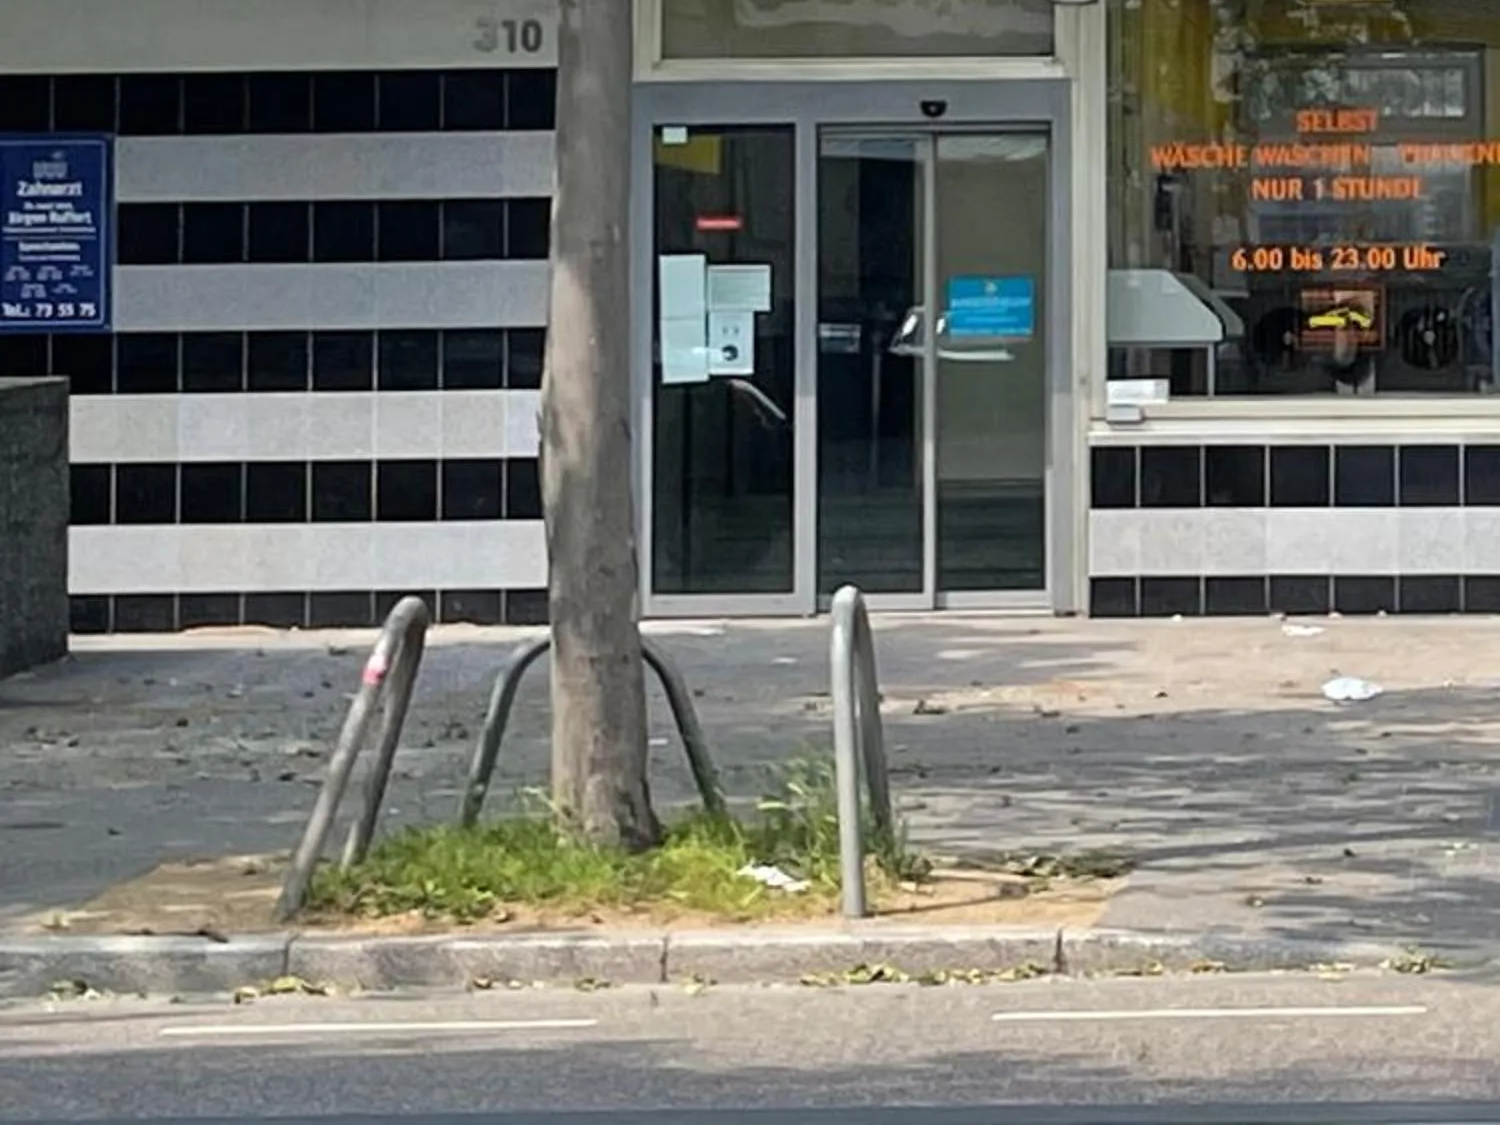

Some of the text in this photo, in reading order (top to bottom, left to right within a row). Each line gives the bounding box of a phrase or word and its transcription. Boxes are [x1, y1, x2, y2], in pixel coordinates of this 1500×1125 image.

[473, 17, 542, 53] 310
[1151, 139, 1249, 169] WÄSCHE
[1251, 177, 1303, 201] NUR
[1313, 177, 1325, 202] 1
[1232, 245, 1446, 271] 6.00 bis 23.00 Uhr
